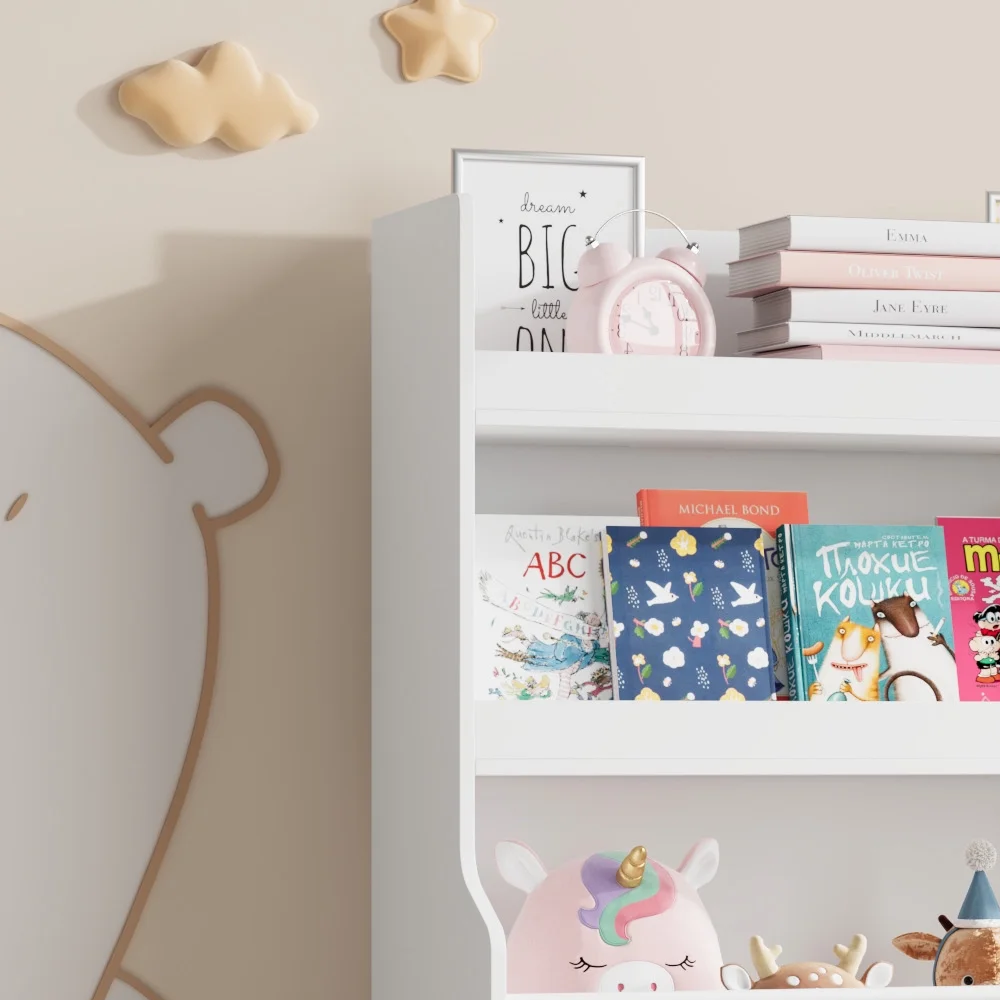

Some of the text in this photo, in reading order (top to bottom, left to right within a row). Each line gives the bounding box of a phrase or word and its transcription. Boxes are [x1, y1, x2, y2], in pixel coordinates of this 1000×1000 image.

[520, 192, 576, 214] dream
[531, 299, 567, 320] little
[872, 299, 948, 315] JANE EYRE
[679, 504, 780, 516] MICHAEL BOND
[969, 536, 996, 544] TURMA
[523, 551, 587, 580] ABC
